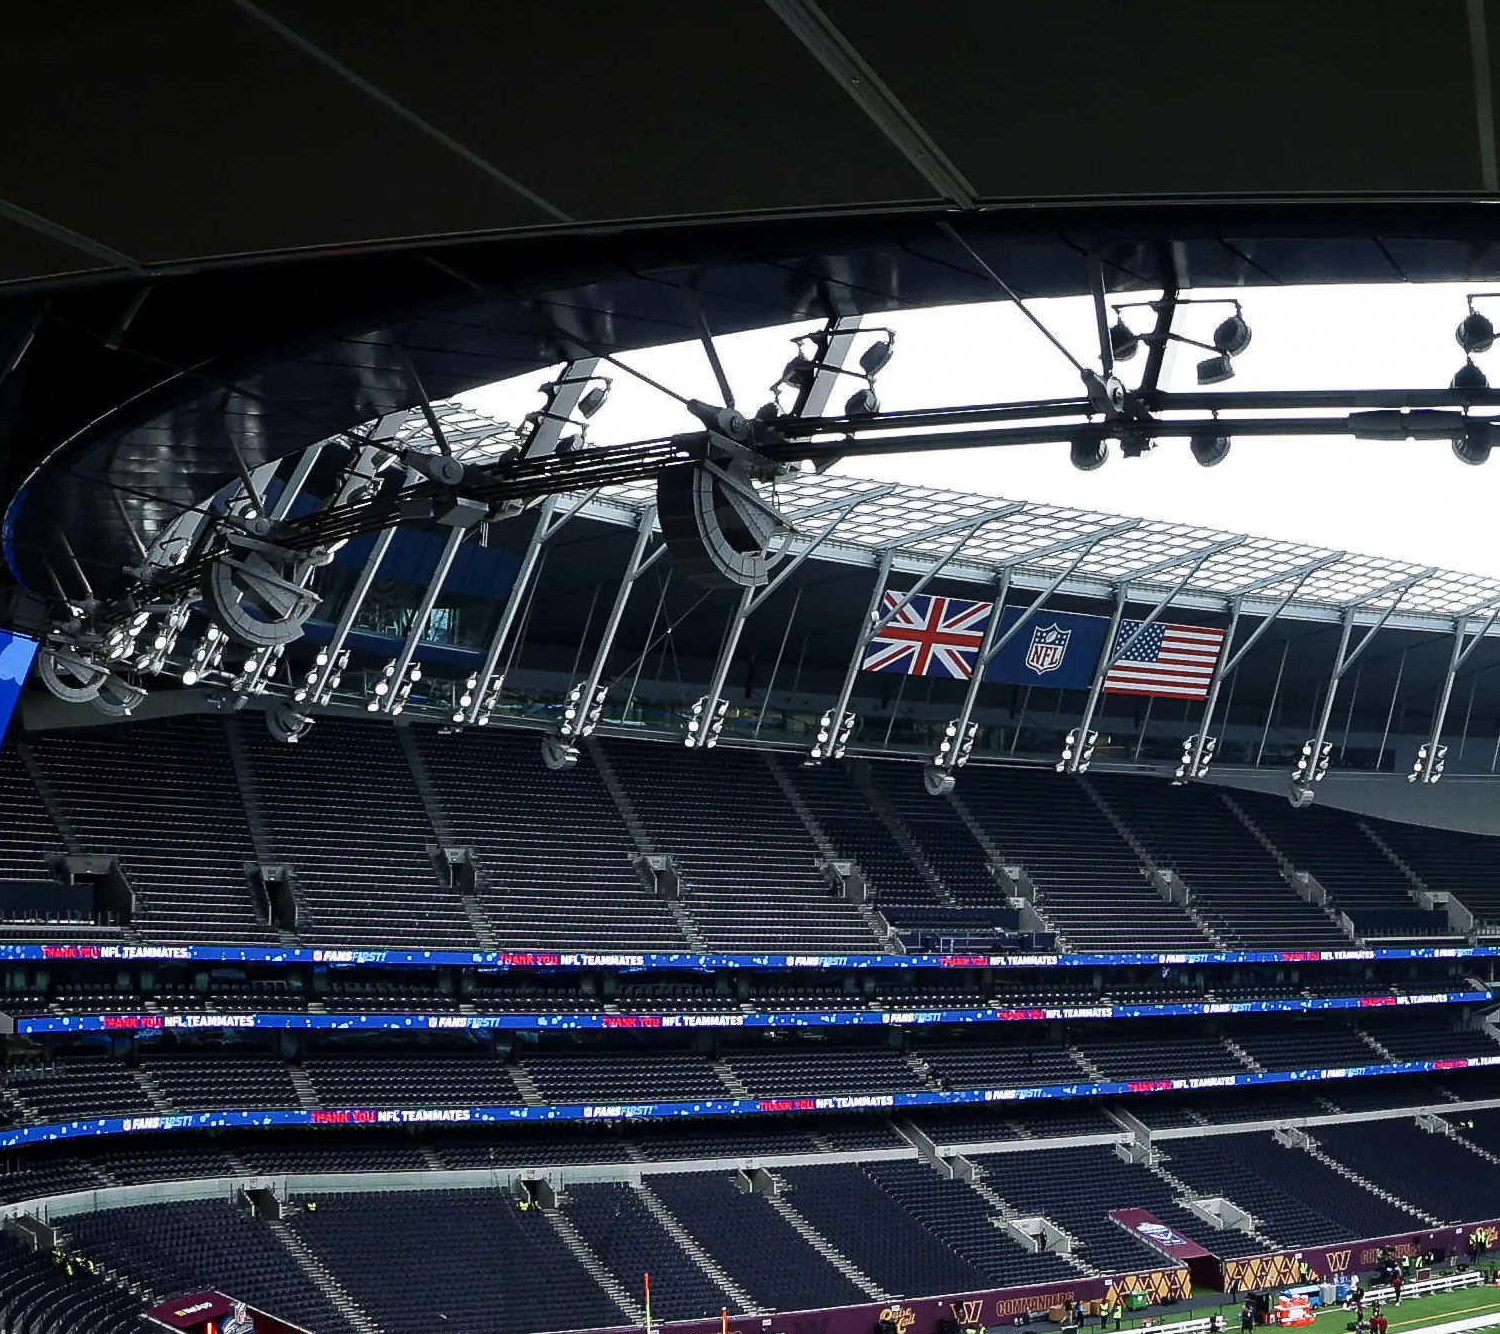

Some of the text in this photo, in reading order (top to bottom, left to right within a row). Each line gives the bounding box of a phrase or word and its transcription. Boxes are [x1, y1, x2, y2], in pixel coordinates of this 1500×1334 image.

[1029, 645, 1060, 665] NFL
[101, 946, 122, 958] NFL
[122, 946, 188, 958] TEAMMATES
[560, 955, 581, 966] NFL
[581, 955, 644, 966] TEAMMATES
[164, 1015, 185, 1027] NFL
[186, 1015, 255, 1027] TEAMMATES
[662, 1016, 682, 1027] NFL
[682, 1016, 744, 1027] TEAMMATES
[816, 1098, 835, 1109] NFL
[836, 1096, 894, 1108] TEAMMATES
[311, 1111, 350, 1123] THANK
[377, 1111, 400, 1123] NFL
[401, 1109, 471, 1122] TEAMMATES
